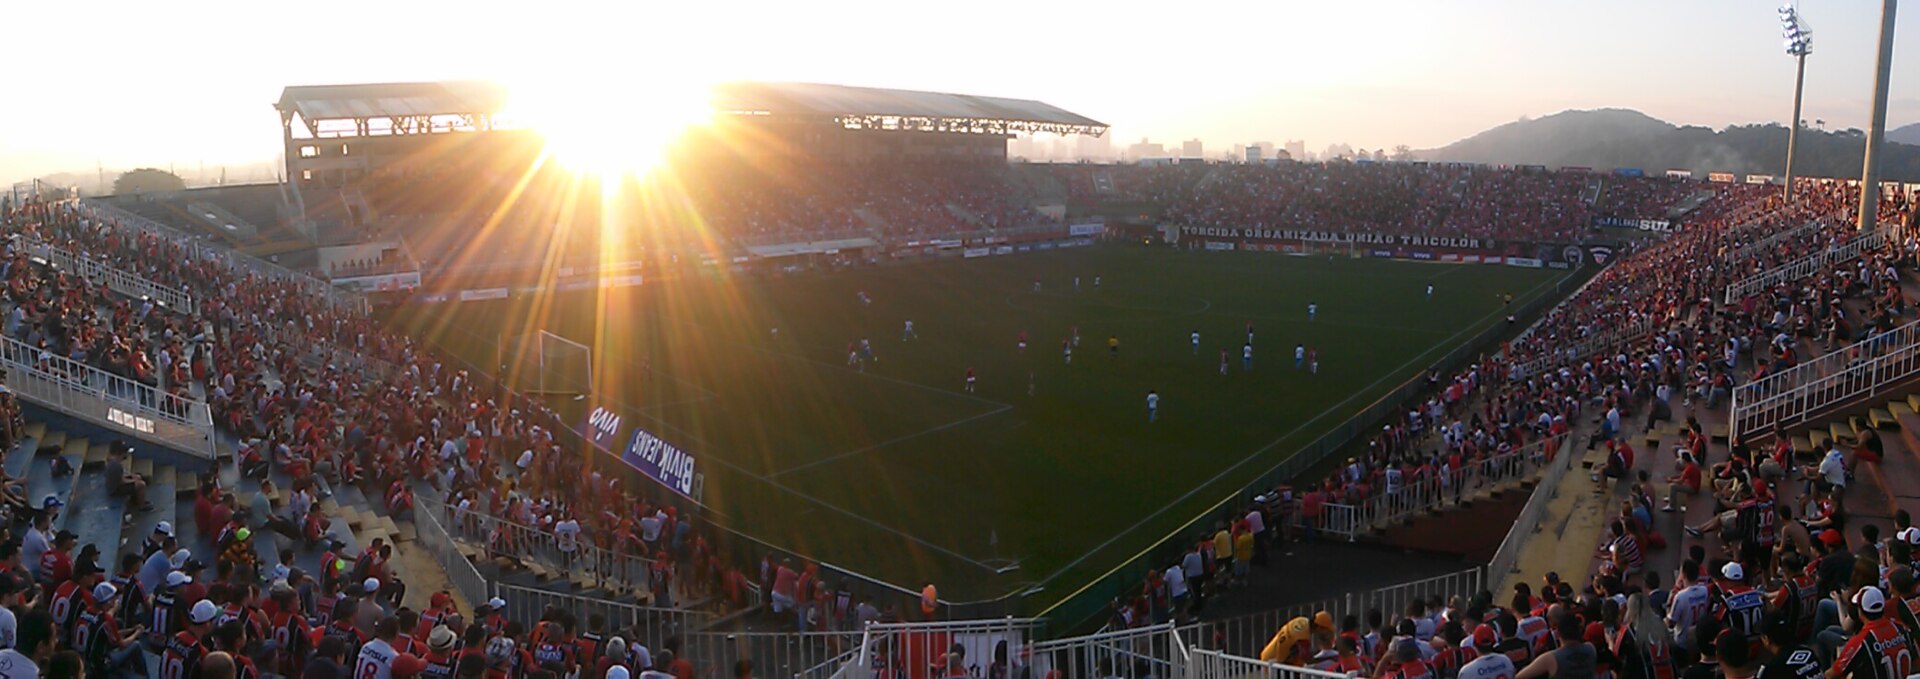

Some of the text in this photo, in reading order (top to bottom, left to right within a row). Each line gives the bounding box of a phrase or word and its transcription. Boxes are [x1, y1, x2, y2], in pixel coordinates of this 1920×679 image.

[1182, 226, 1239, 237] TORCIDA
[1245, 228, 1340, 242] ORGANIZADA
[1401, 235, 1480, 248] TRICOLOR
[1639, 219, 1673, 233] SUL
[632, 430, 663, 463] JEANS
[1760, 510, 1774, 527] 10
[357, 656, 378, 679] 18
[1881, 648, 1912, 679] 10
